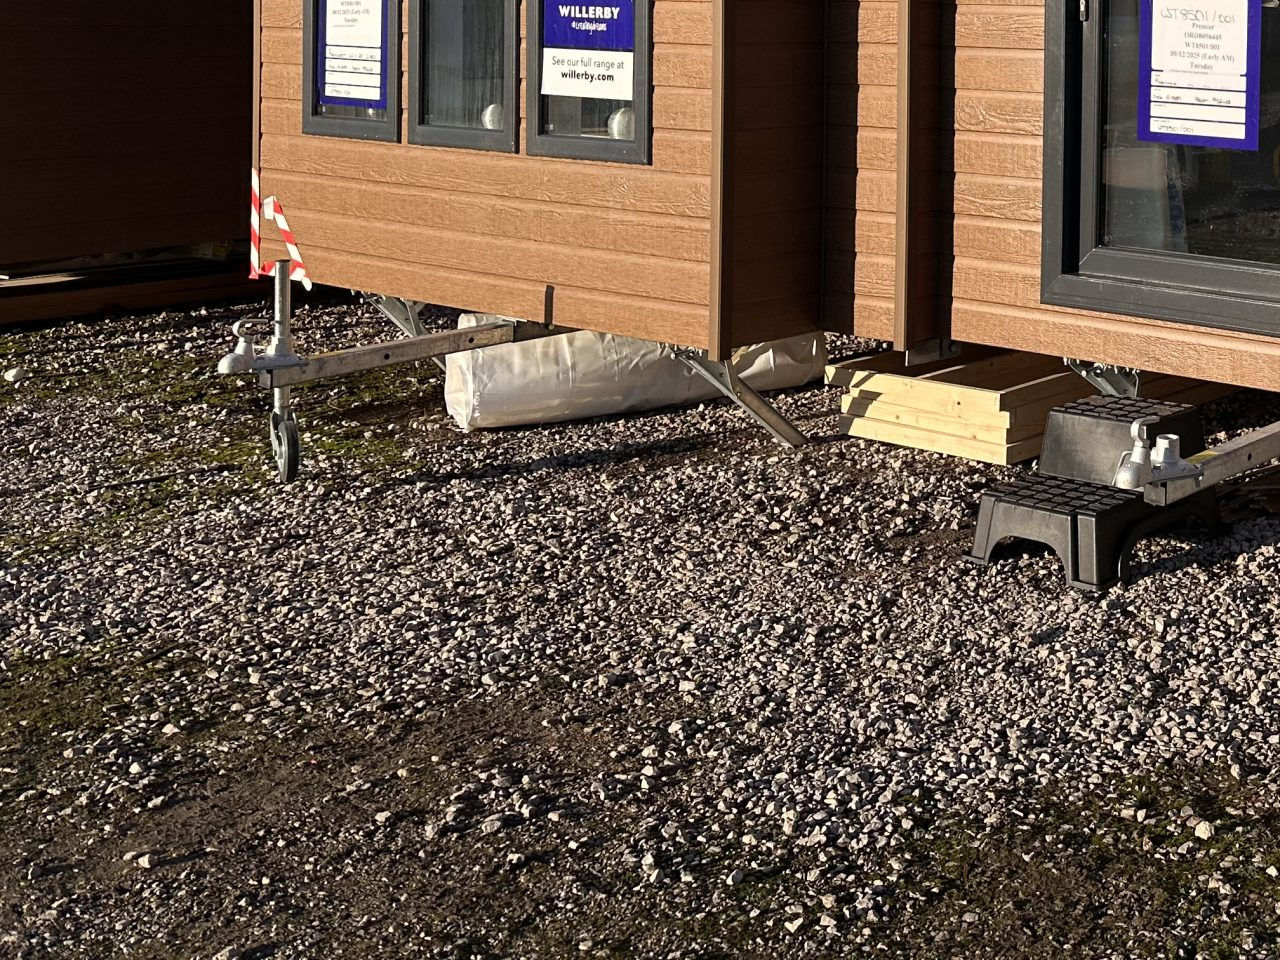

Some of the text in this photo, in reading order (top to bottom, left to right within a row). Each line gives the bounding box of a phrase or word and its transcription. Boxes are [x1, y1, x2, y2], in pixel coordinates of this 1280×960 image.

[559, 4, 620, 19] WILLERBY
[552, 55, 624, 71] See our full range at
[561, 69, 614, 82] willerby.com
